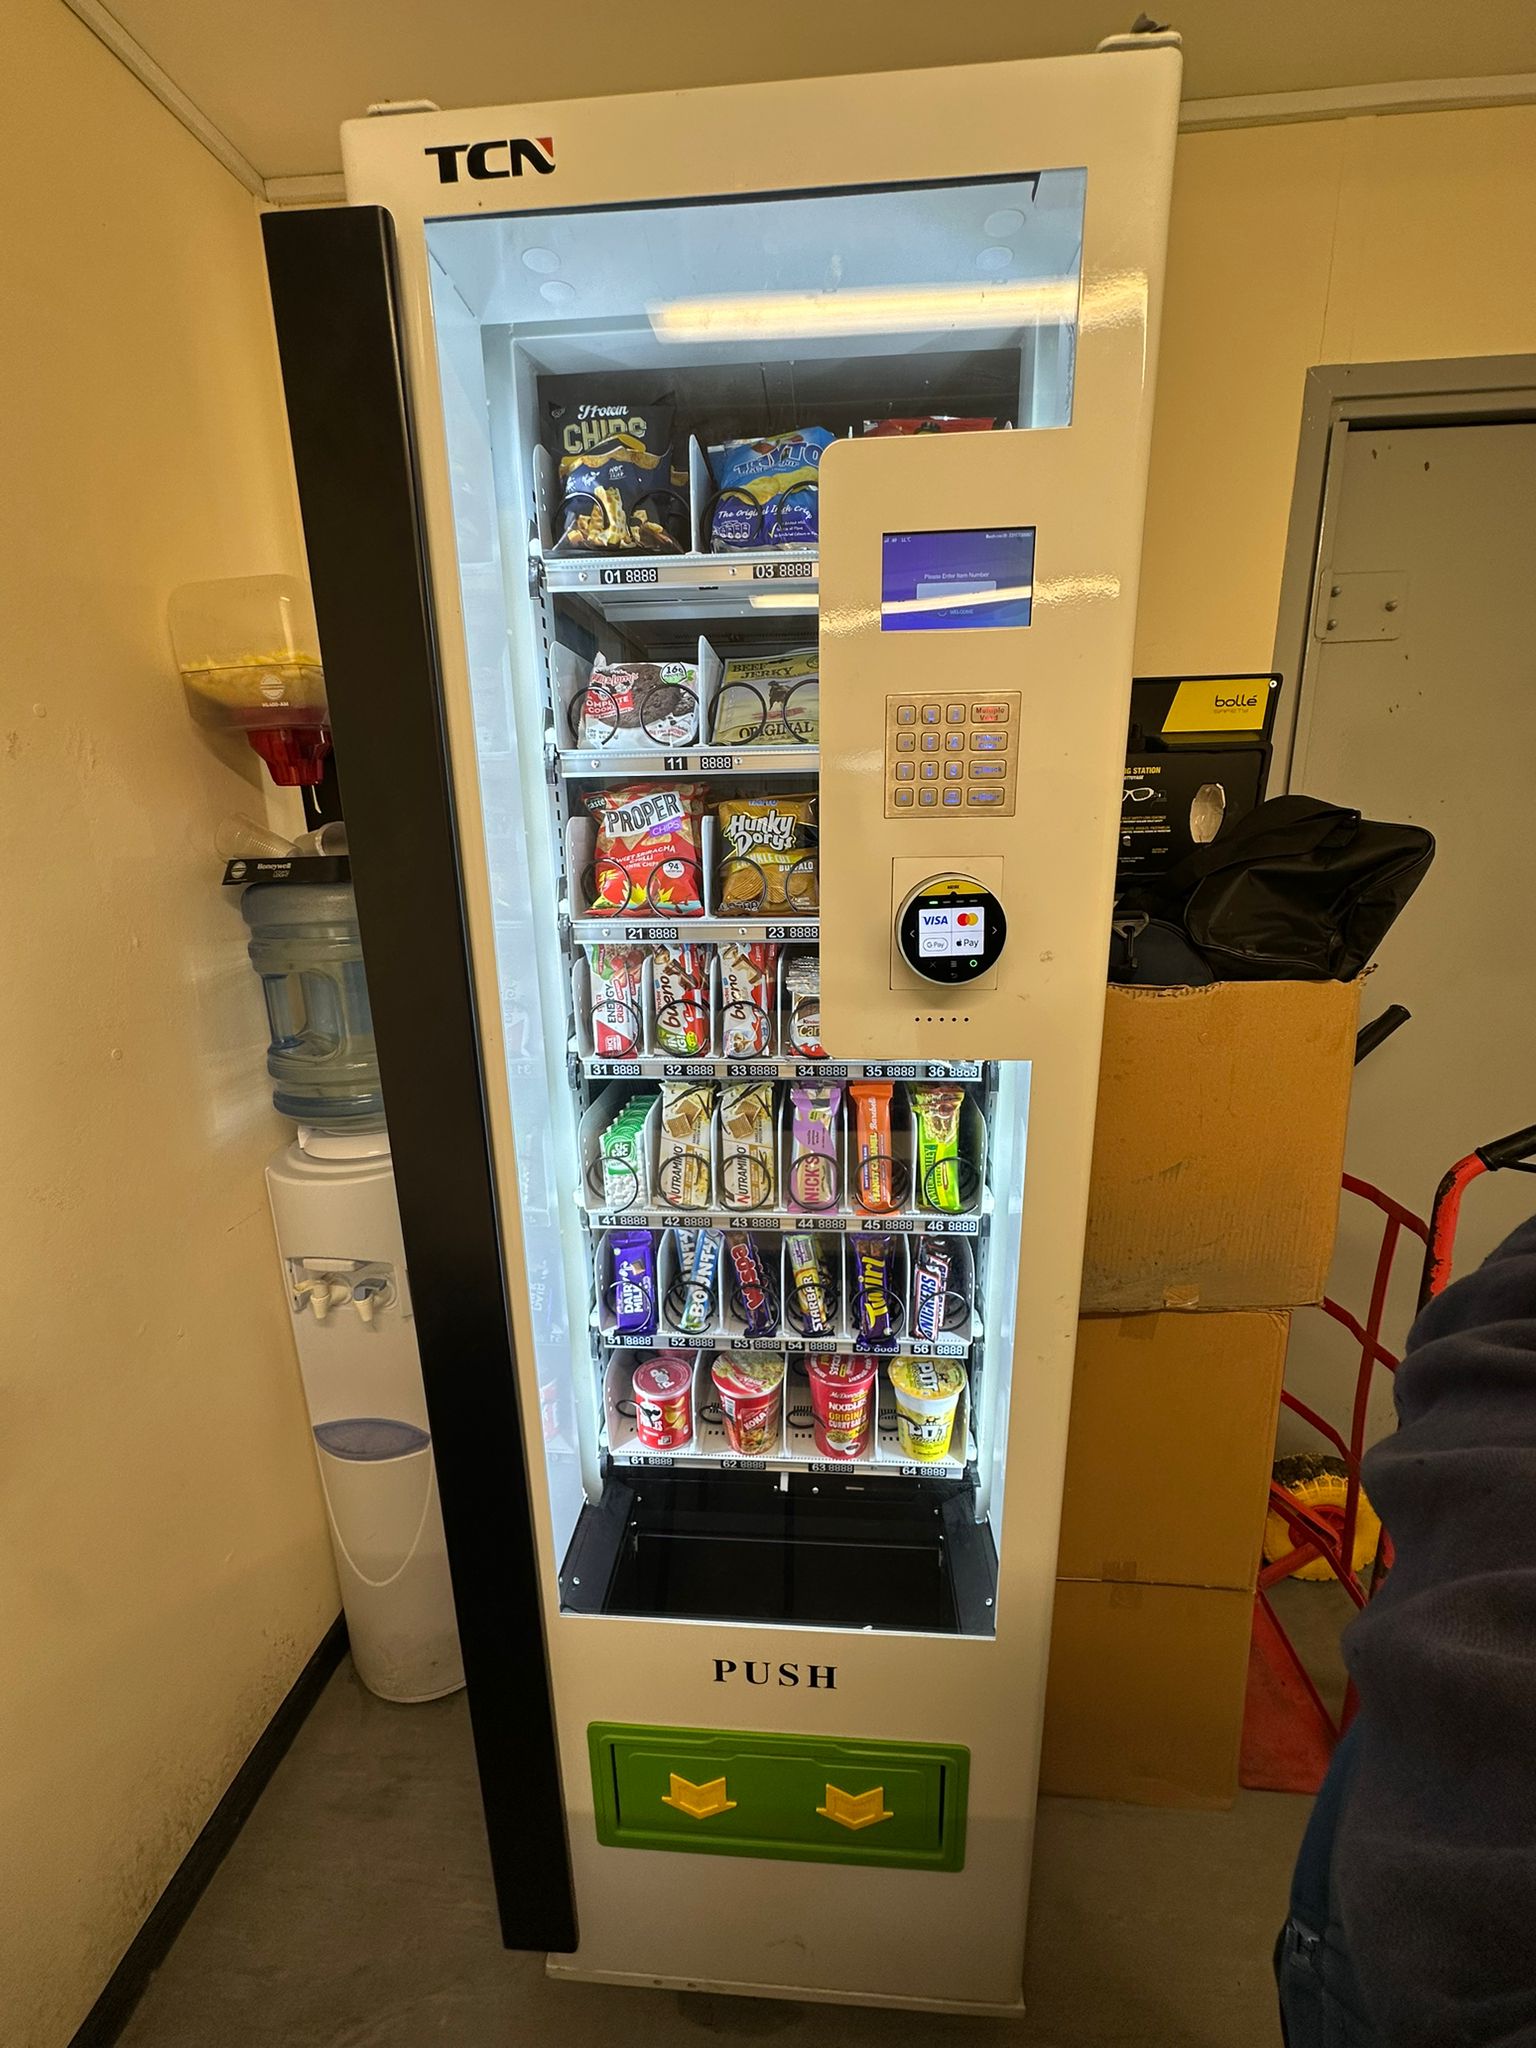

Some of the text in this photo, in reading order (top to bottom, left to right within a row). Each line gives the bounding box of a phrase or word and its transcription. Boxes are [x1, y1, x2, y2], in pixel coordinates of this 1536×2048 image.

[424, 137, 556, 184] TCN
[578, 404, 629, 420] Protein
[718, 511, 734, 519] The
[736, 506, 769, 520] Origial
[756, 563, 811, 578] 03 8888
[604, 568, 657, 584] 01 8888
[733, 663, 768, 672] BEEF
[741, 666, 794, 678] JERKY
[1214, 694, 1258, 707] bollé
[667, 756, 731, 770] 11 8888
[1133, 767, 1161, 775] STATION
[606, 793, 680, 832] PROPER
[652, 819, 681, 836] CHIPS
[726, 810, 794, 838] Hunky
[734, 830, 793, 857] Dorys
[668, 862, 680, 870] 94
[923, 916, 948, 925] VISA
[628, 928, 676, 939] 21 8888
[769, 926, 818, 938] 23 8888
[964, 939, 979, 948] Pay
[660, 975, 681, 1028] bueno
[593, 1065, 640, 1074] 31 8888
[666, 1065, 713, 1075] 32 8888
[731, 1065, 777, 1075] 33 8888
[798, 1066, 846, 1076] 34 8888
[866, 1066, 914, 1076] 35 8888
[928, 1066, 945, 1077] 36
[614, 1142, 630, 1151] tic
[611, 1149, 629, 1157] tac
[669, 1145, 683, 1204] NUTRAMINO
[736, 1146, 750, 1204] NUTRAMINO
[602, 1216, 646, 1224] 41 8888
[664, 1217, 711, 1226] 42 8888
[732, 1218, 779, 1227] 43 8888
[798, 1219, 845, 1228] 44 8888
[864, 1220, 912, 1229] 45 8888
[927, 1221, 976, 1231] 46 8888
[689, 1237, 718, 1316] BOUNTY
[861, 1256, 888, 1328] Twirl
[803, 1275, 823, 1332] STARBAR
[671, 1338, 685, 1346] 52
[734, 1340, 748, 1348] 53
[788, 1341, 802, 1349] 54
[914, 1344, 929, 1353] 56
[723, 1460, 736, 1468] 62
[903, 1467, 916, 1475] 64
[712, 1659, 837, 1690] PUSH
